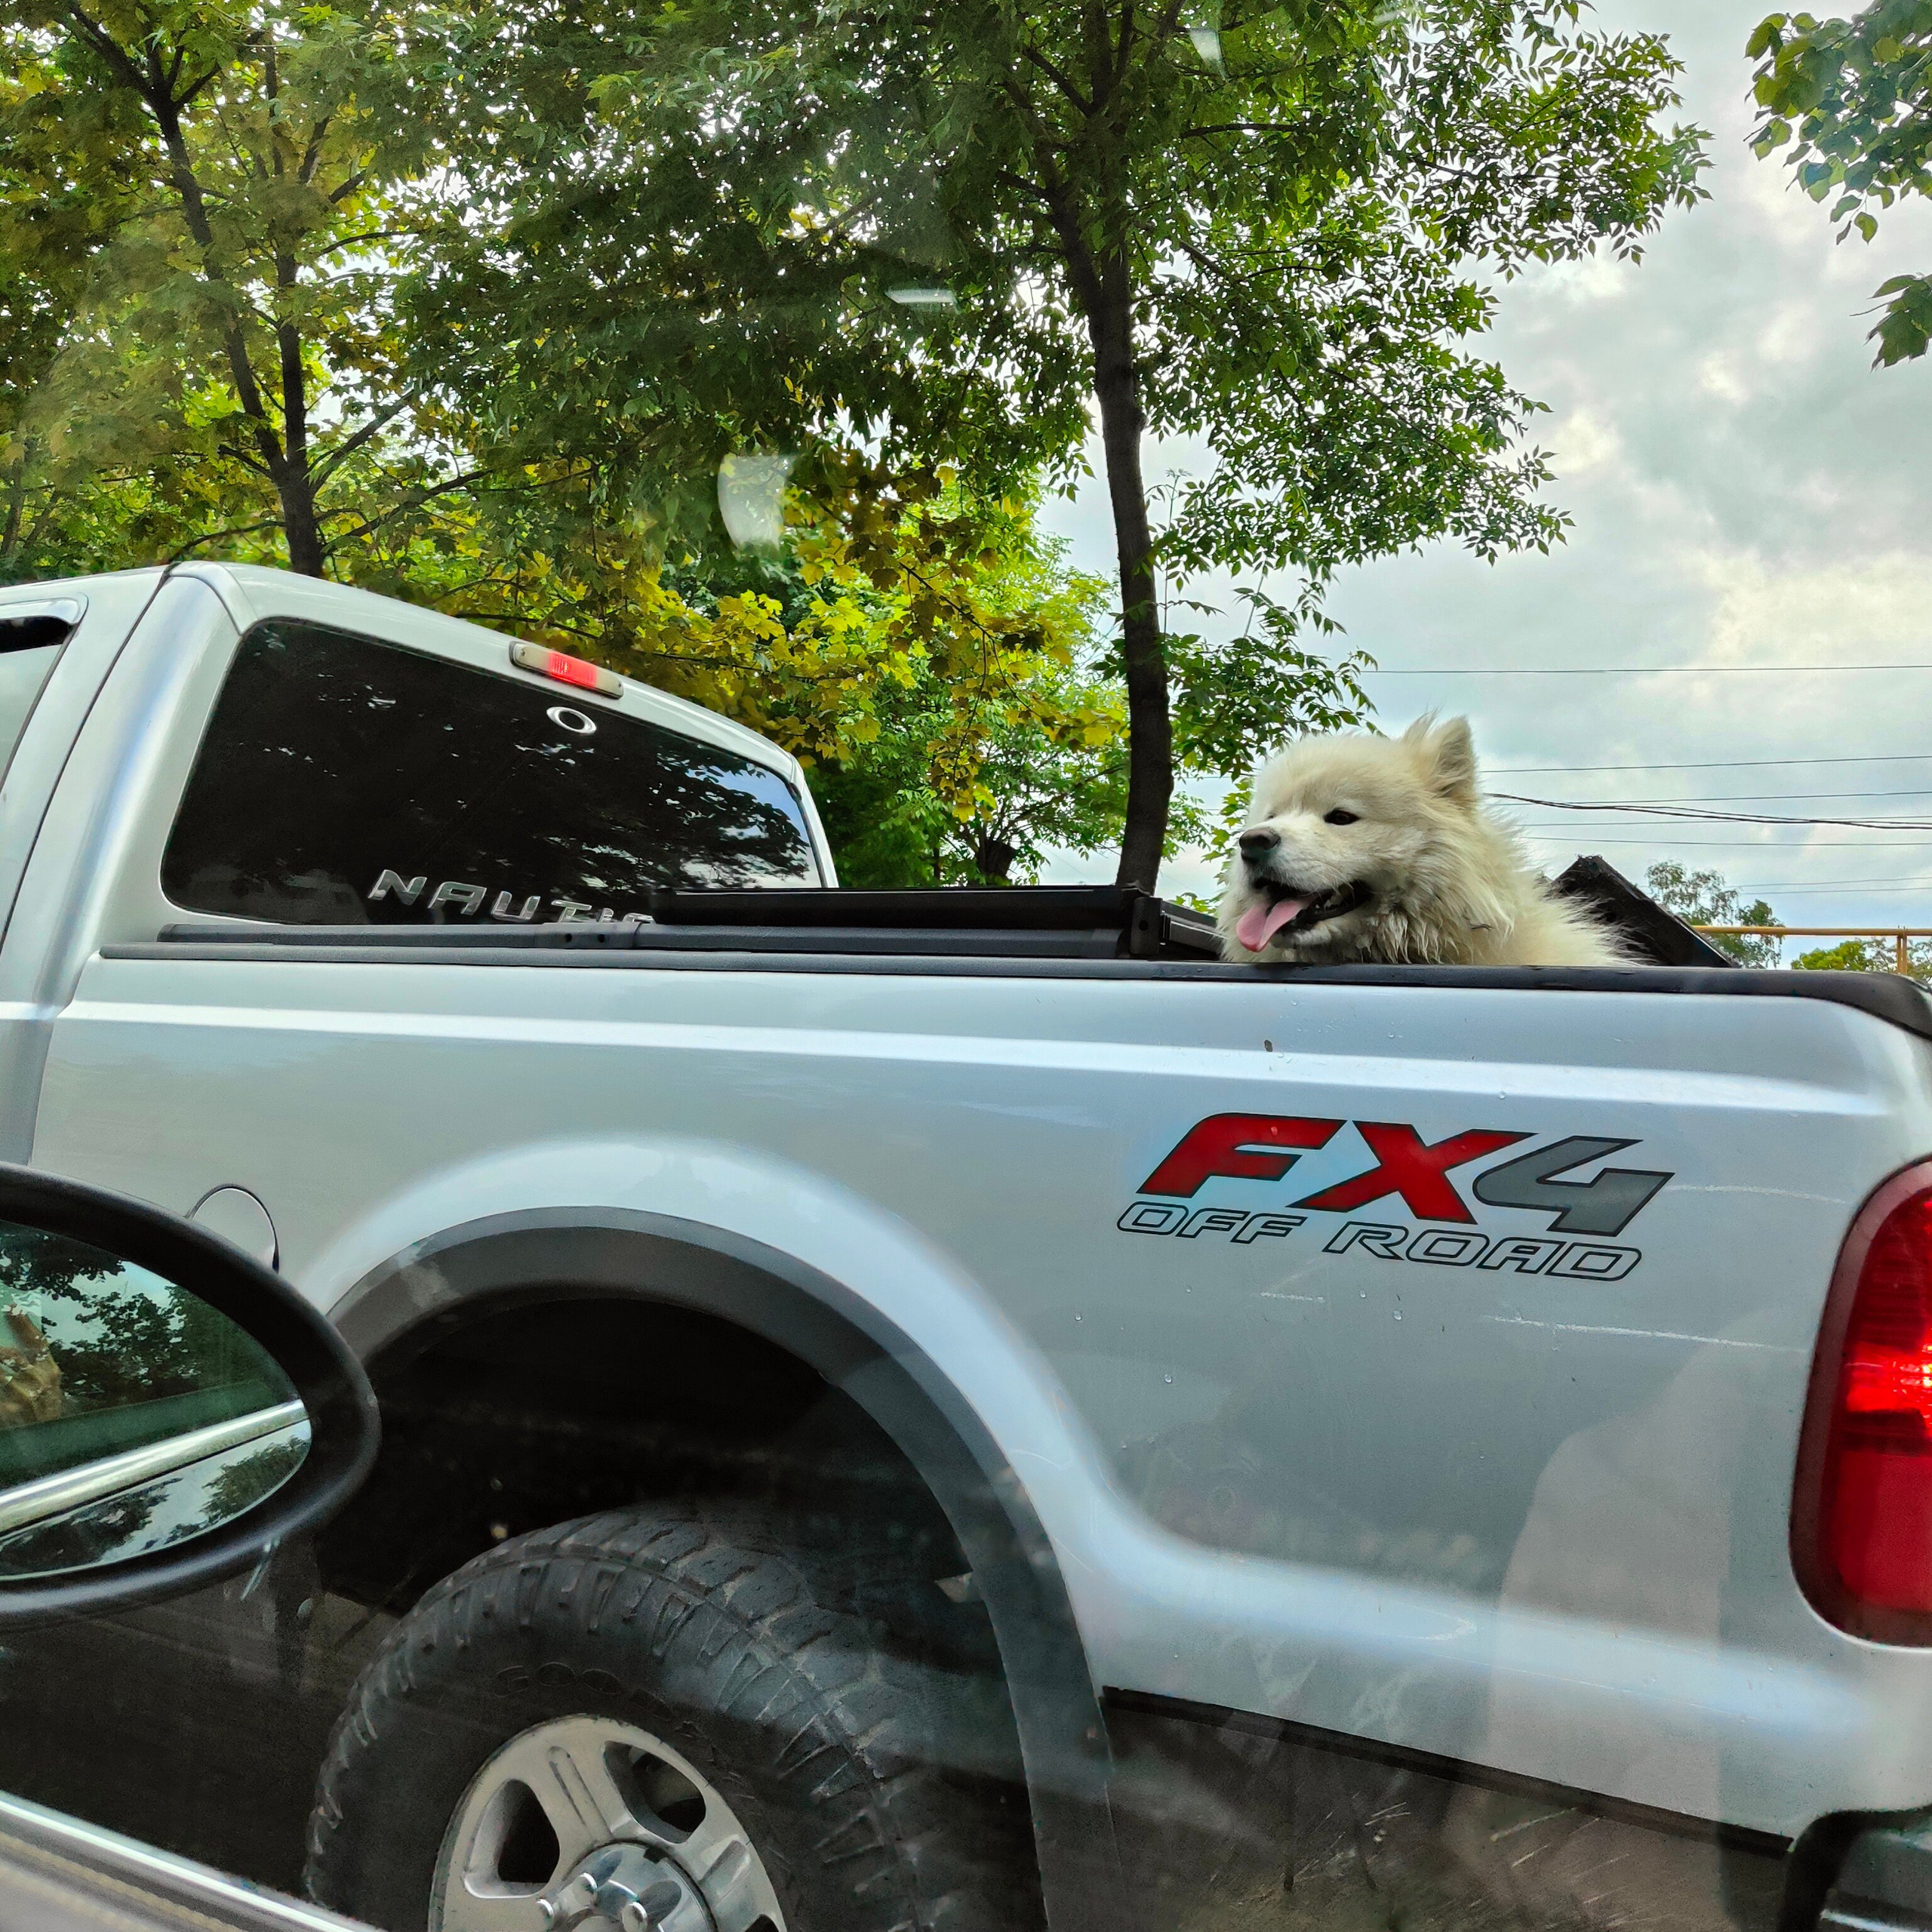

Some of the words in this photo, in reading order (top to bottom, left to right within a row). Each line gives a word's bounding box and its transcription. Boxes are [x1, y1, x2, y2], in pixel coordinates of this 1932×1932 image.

[1136, 1112, 1675, 1236] FX4
[1117, 1201, 1307, 1244] OFF
[1322, 1221, 1641, 1281] ROAD
